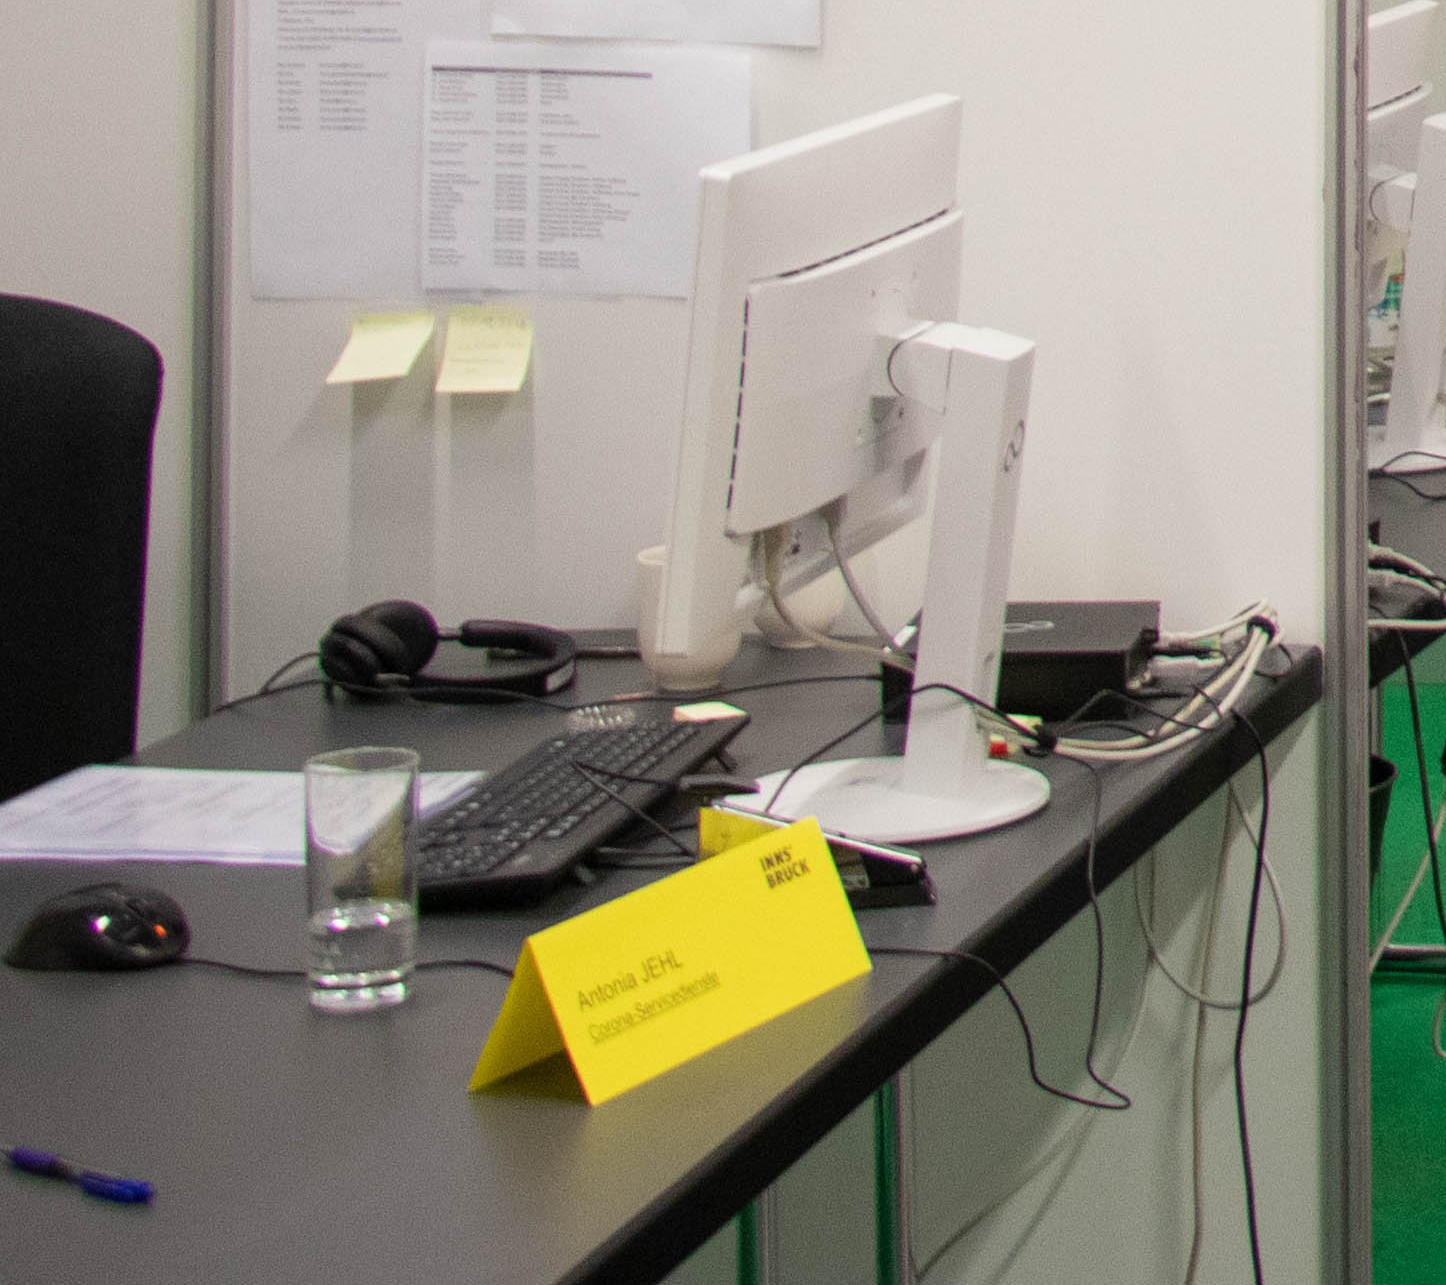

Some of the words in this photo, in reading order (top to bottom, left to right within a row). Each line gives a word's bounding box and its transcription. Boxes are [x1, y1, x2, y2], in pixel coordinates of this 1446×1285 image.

[766, 857, 811, 889] BRUCK
[577, 971, 639, 1012] Antonia
[640, 949, 683, 984] JEHL
